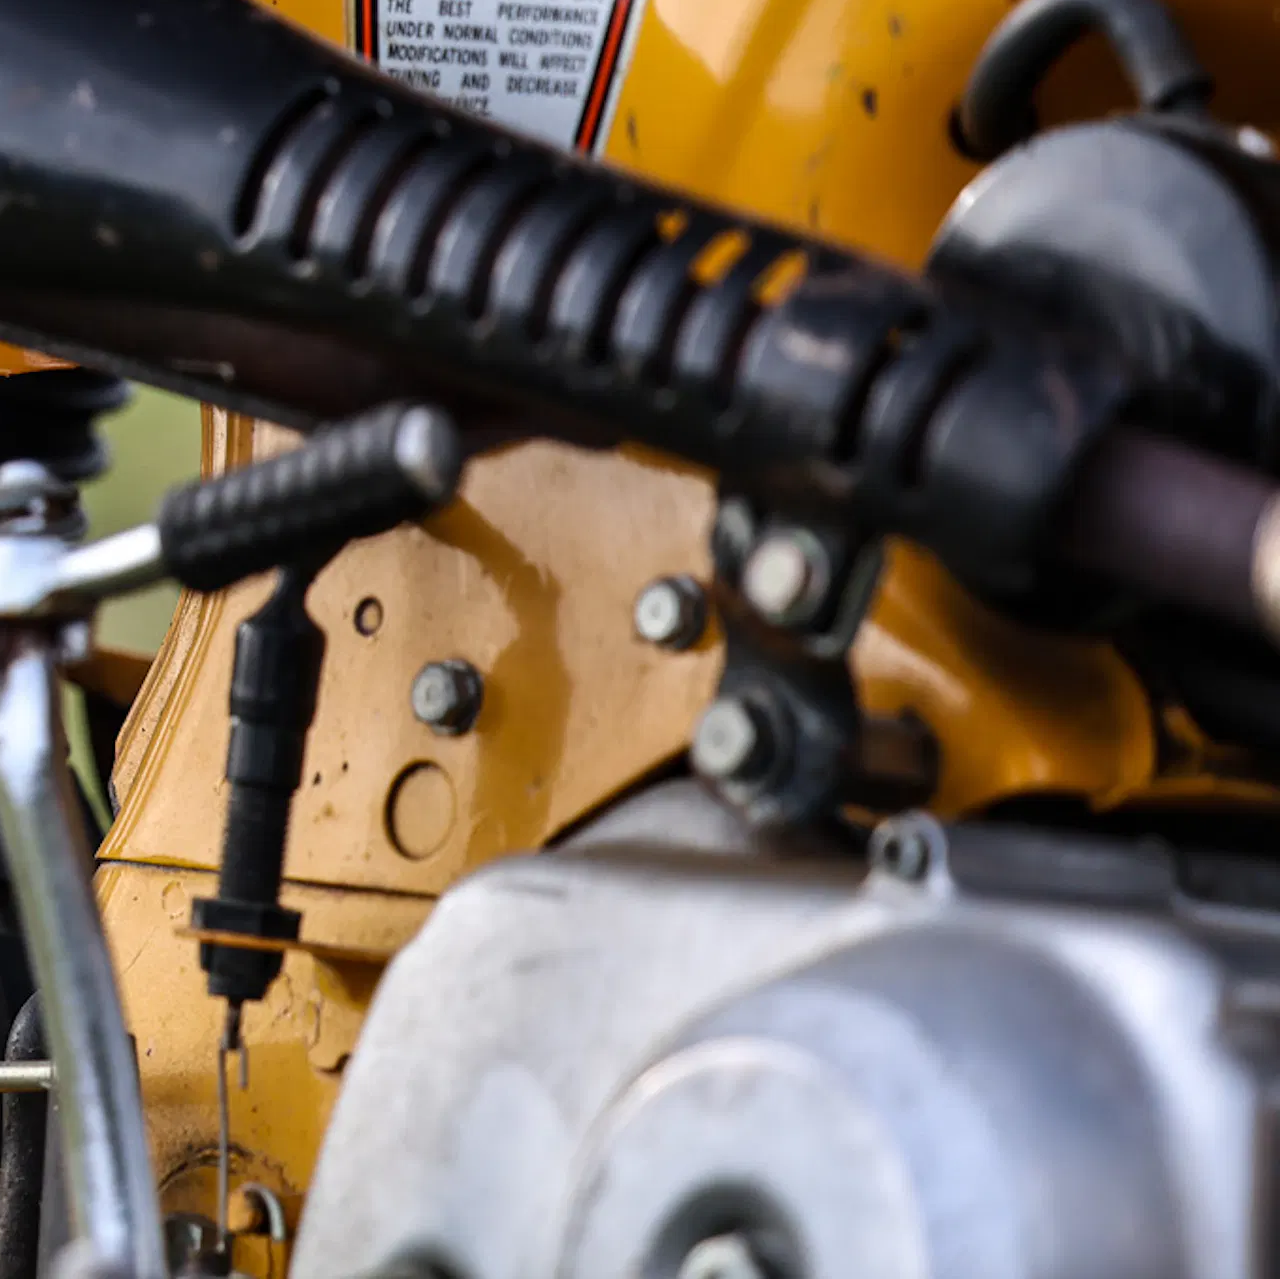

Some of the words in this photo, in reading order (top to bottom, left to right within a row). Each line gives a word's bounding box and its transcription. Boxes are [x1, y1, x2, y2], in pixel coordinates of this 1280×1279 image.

[497, 2, 599, 26] PERFORMANCE
[386, 19, 436, 40] UNDER
[443, 23, 499, 45] NORMAL
[386, 42, 489, 67] MODIFICATIONS
[498, 51, 529, 70] WILL
[460, 70, 490, 92] AND
[506, 74, 578, 98] DECREASE
